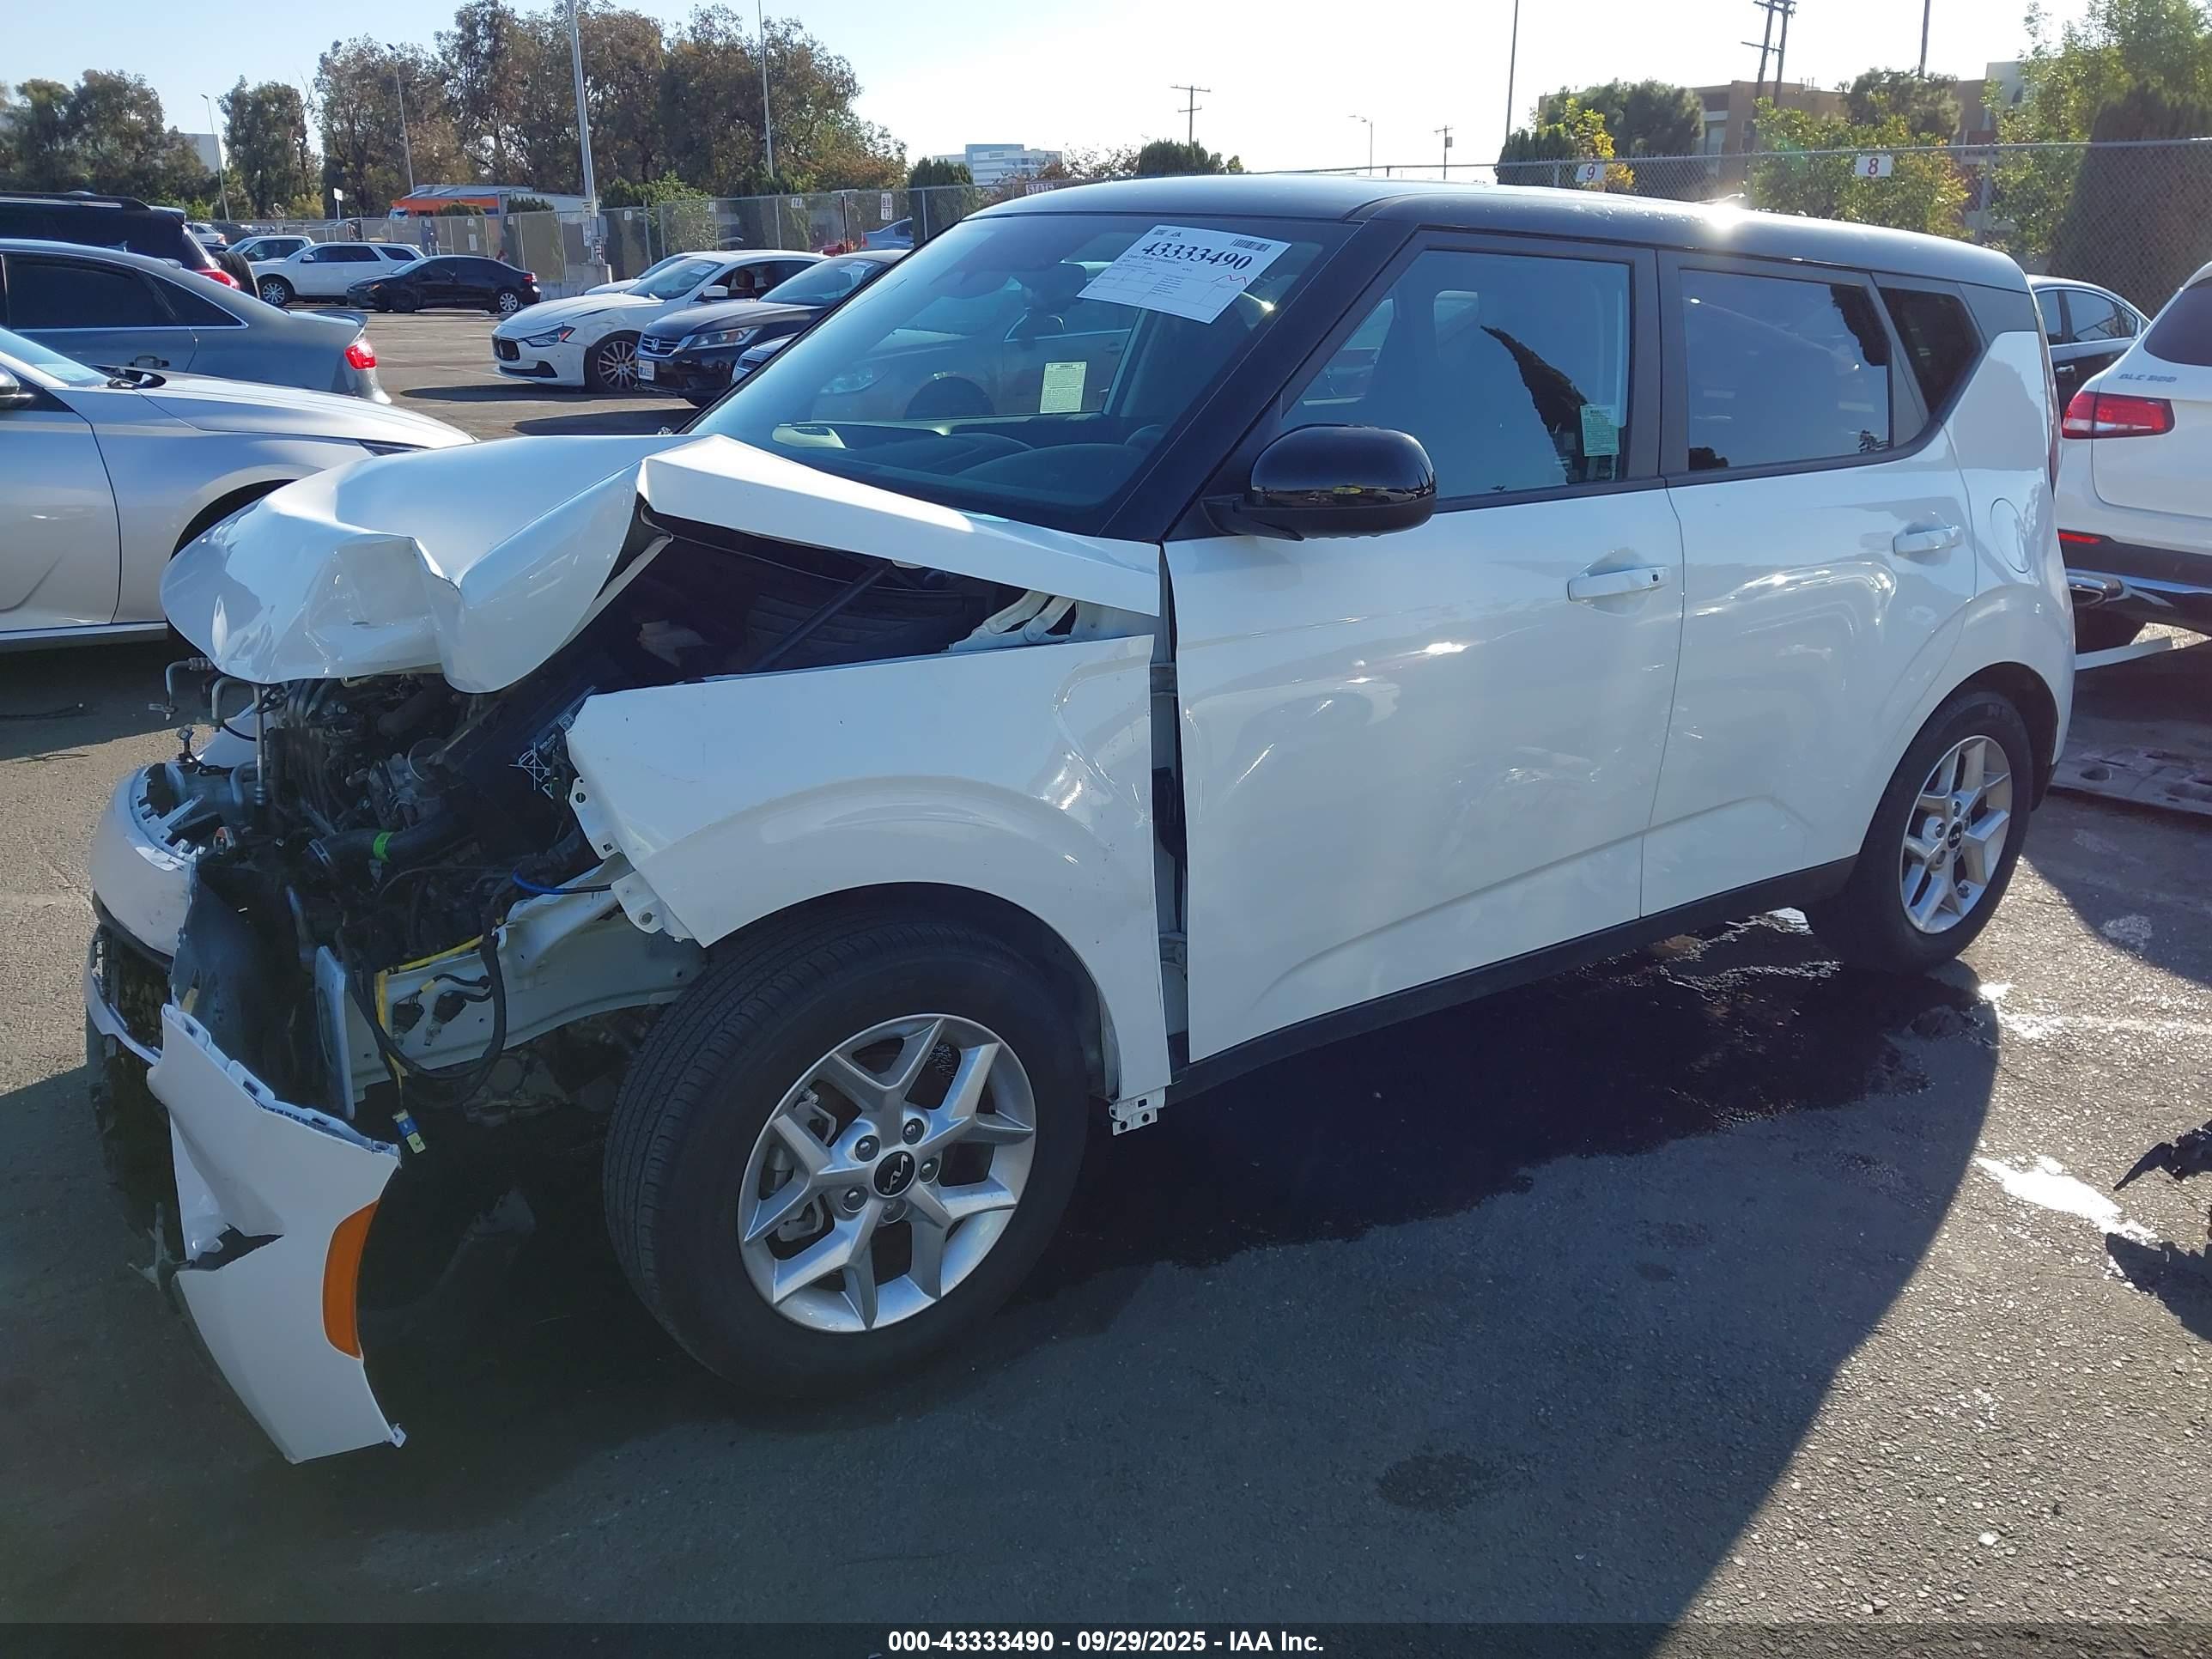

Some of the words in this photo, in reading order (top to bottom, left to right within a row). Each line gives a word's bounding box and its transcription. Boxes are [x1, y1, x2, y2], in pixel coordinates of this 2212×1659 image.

[1587, 166, 1595, 179] 9
[1868, 157, 1879, 175] 8
[1141, 241, 1253, 270] 43333490
